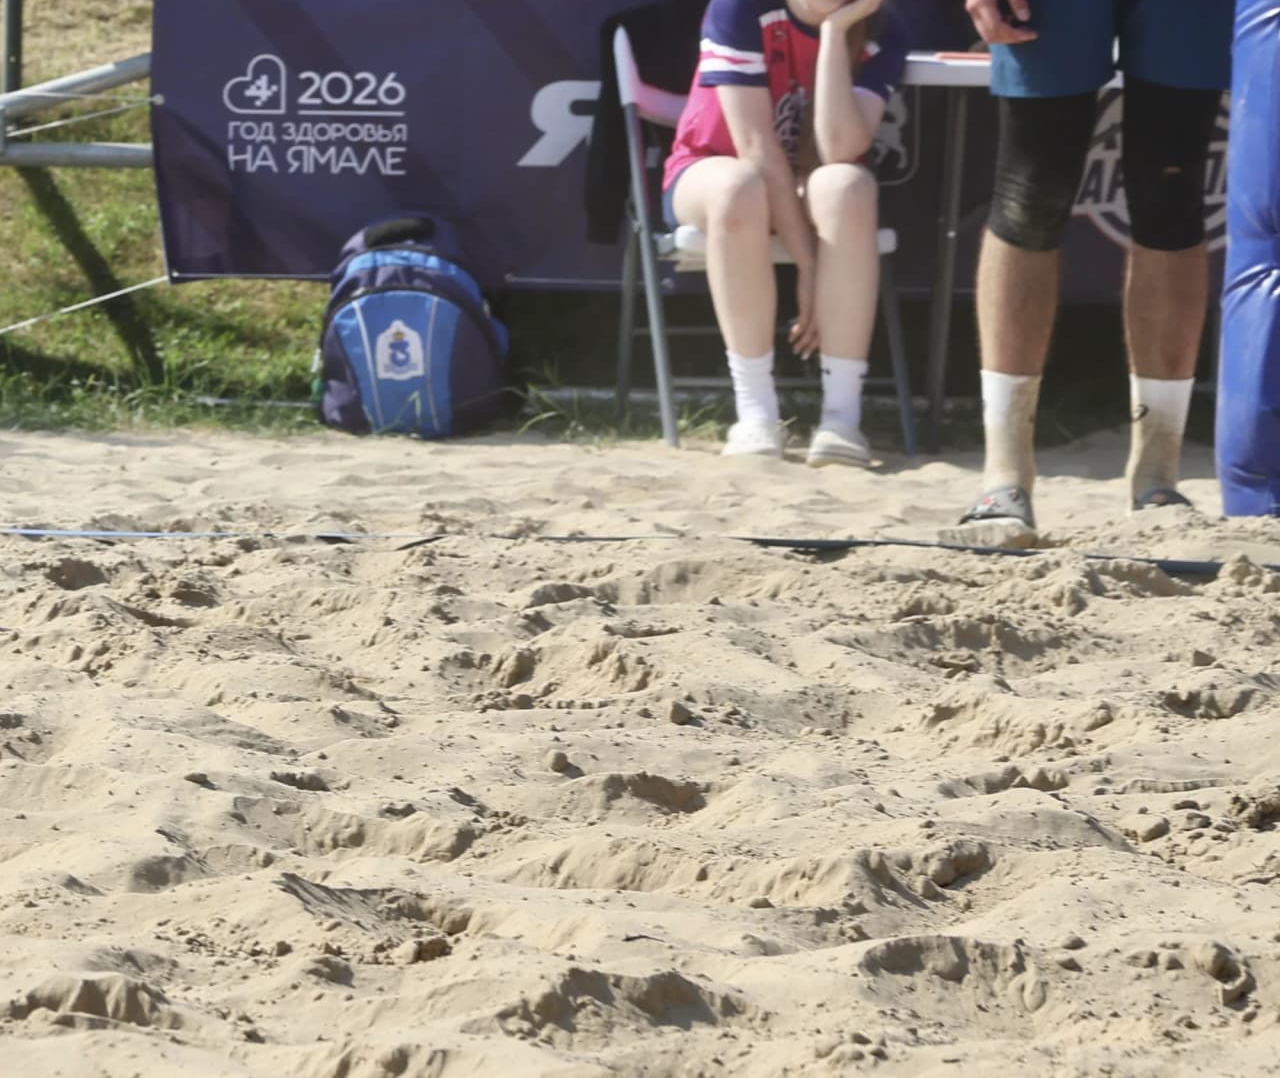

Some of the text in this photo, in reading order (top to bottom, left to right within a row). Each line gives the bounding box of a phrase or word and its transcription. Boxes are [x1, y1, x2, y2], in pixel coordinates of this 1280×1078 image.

[297, 71, 407, 106] 2026
[228, 121, 407, 144] ГОД ЗДОРОВЬЯ
[228, 145, 407, 175] НА ЯМАЛЕ
